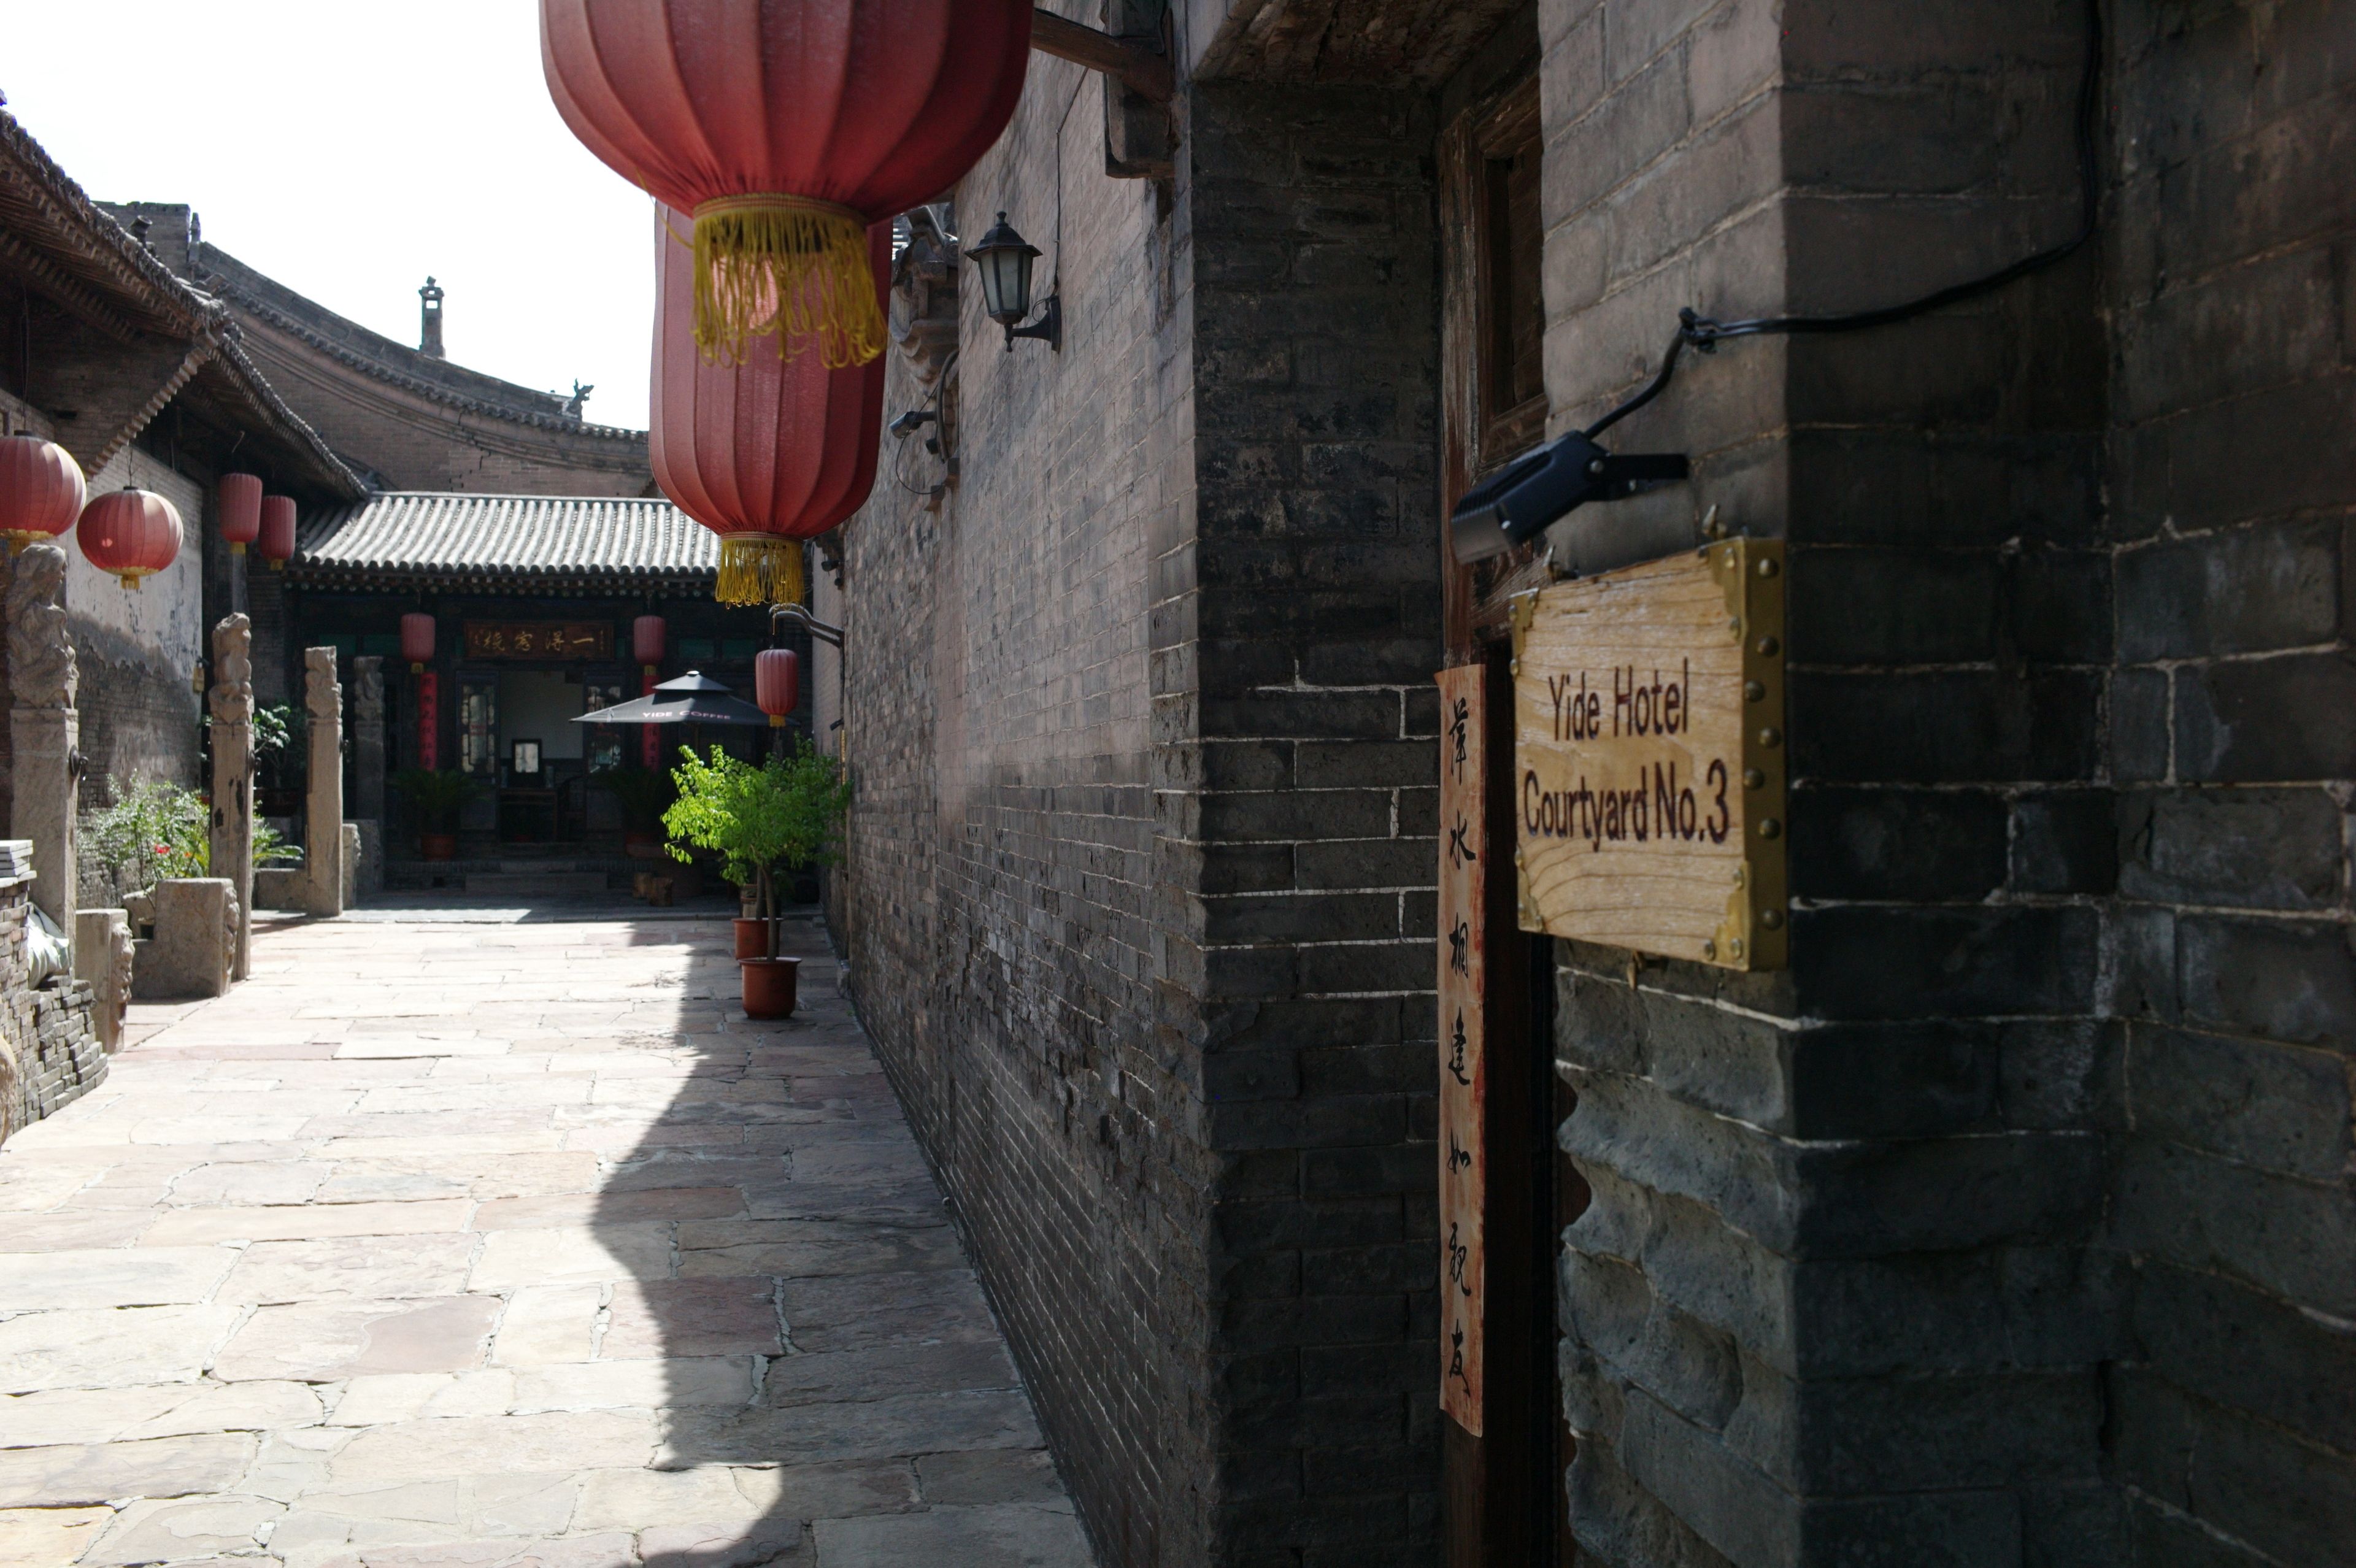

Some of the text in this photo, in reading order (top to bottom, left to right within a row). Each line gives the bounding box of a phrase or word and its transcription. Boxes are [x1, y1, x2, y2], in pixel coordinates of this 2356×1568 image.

[679, 710, 731, 720] COFFEE
[1549, 656, 1689, 741] Yide Hotel
[1524, 758, 1730, 853] Courtyard No.3
